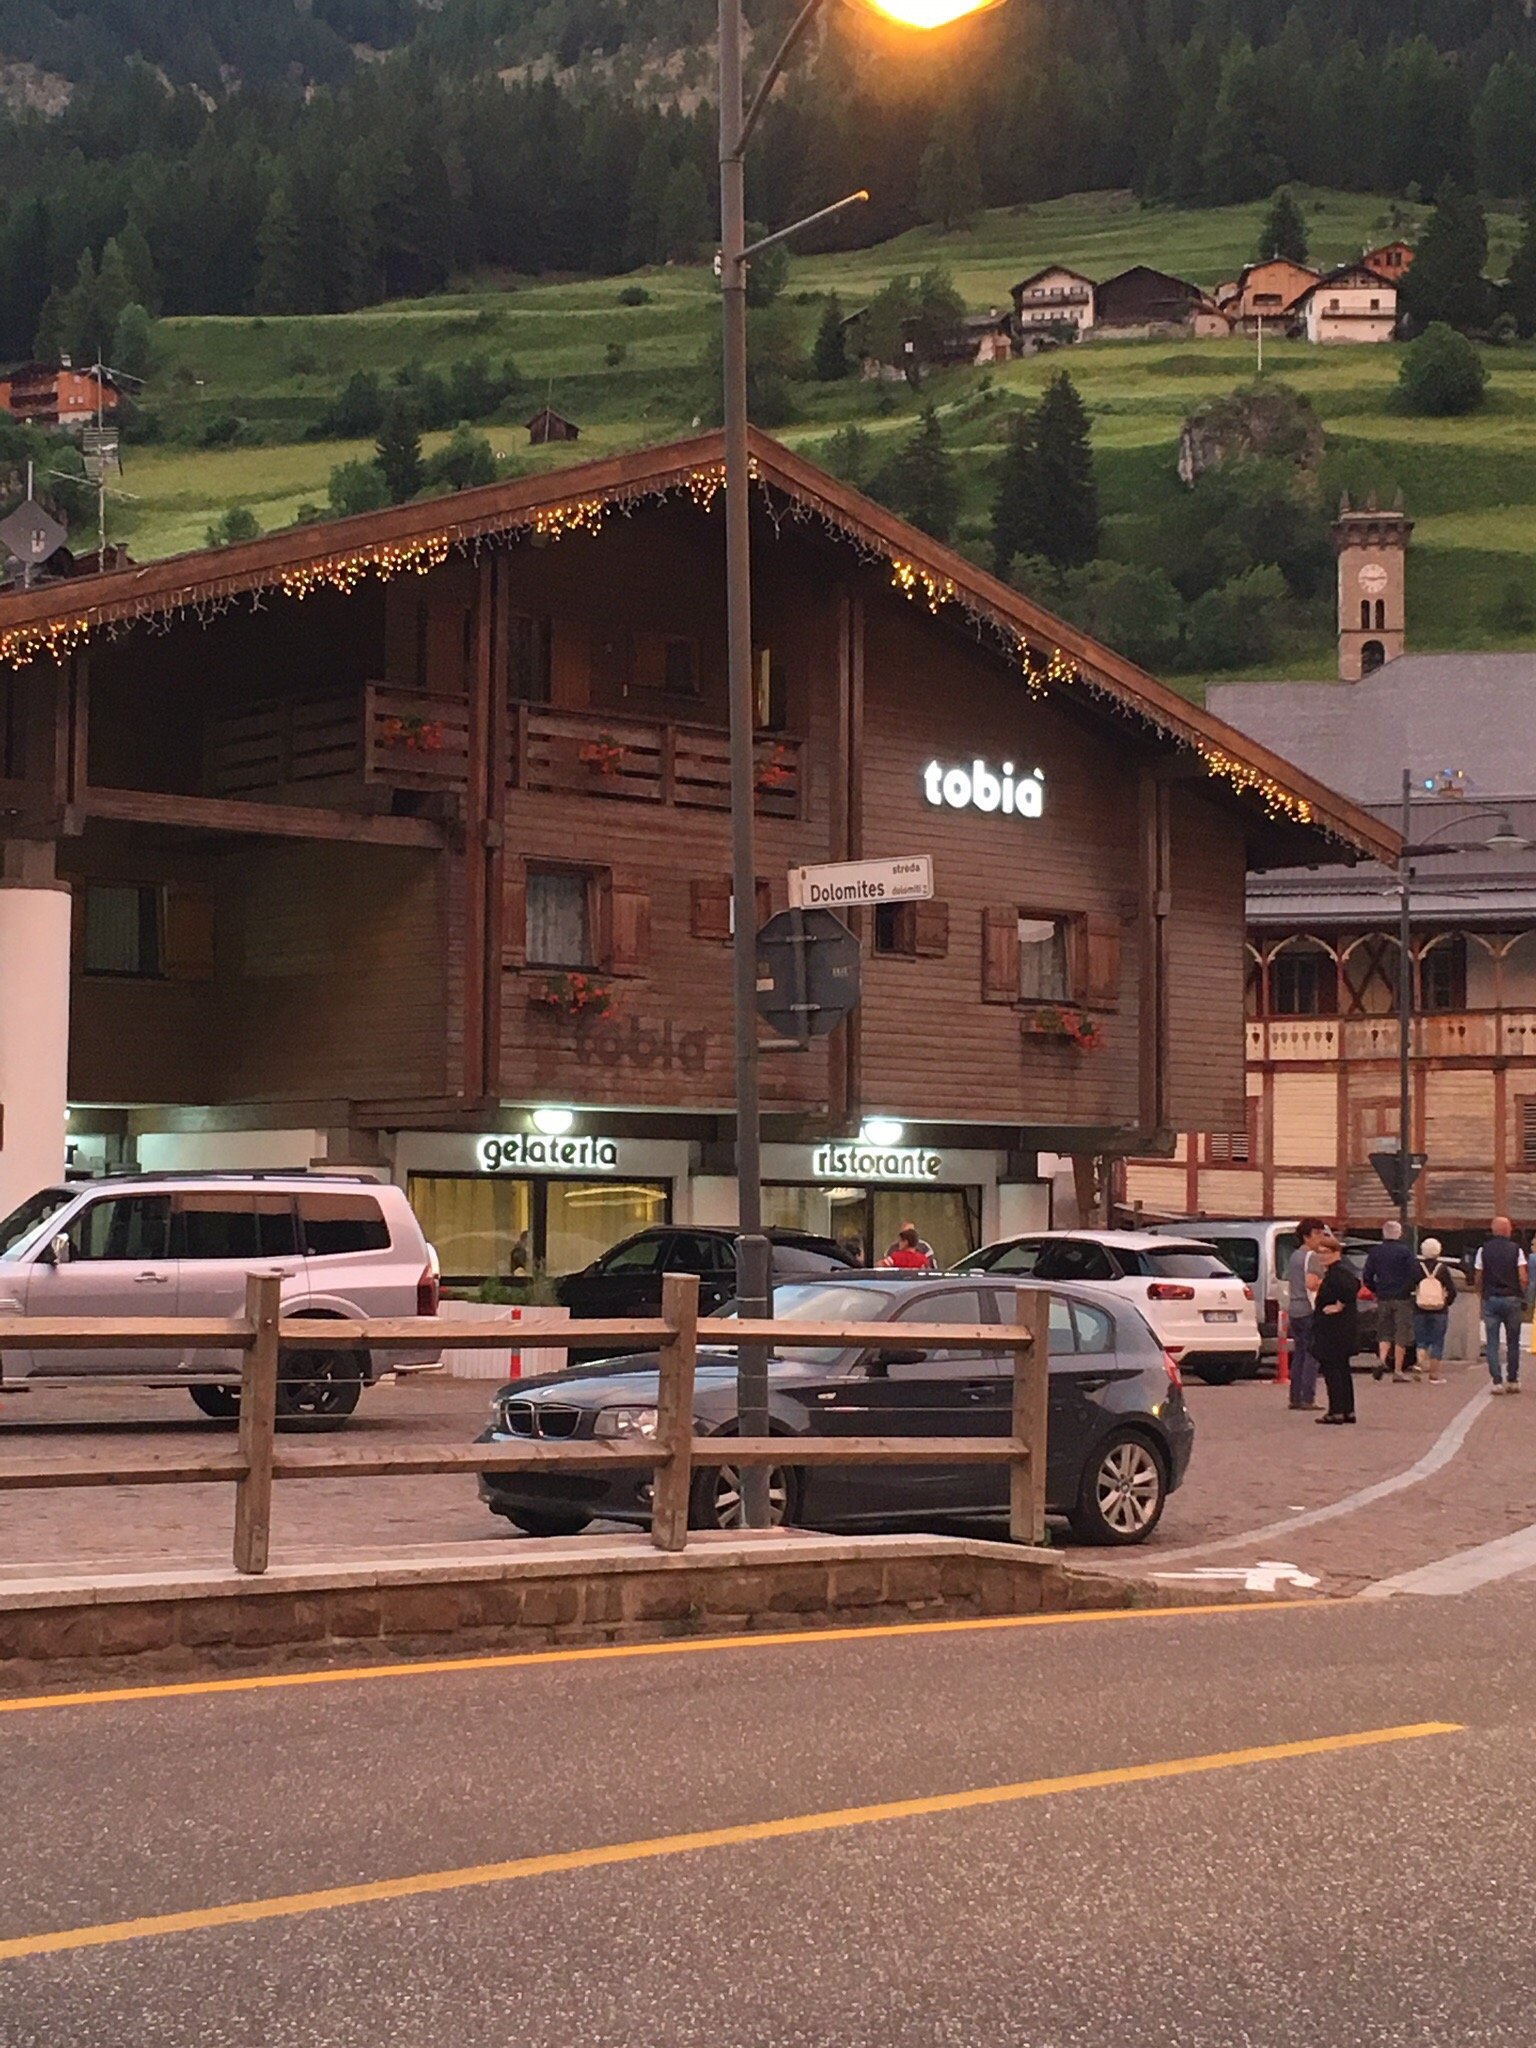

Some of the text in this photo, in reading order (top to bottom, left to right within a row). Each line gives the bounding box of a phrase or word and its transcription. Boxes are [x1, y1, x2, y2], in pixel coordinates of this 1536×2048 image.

[924, 759, 1045, 818] tobià
[810, 880, 885, 903] Dolomites
[482, 1132, 618, 1171] gelateria
[818, 1143, 942, 1176] ristorante
